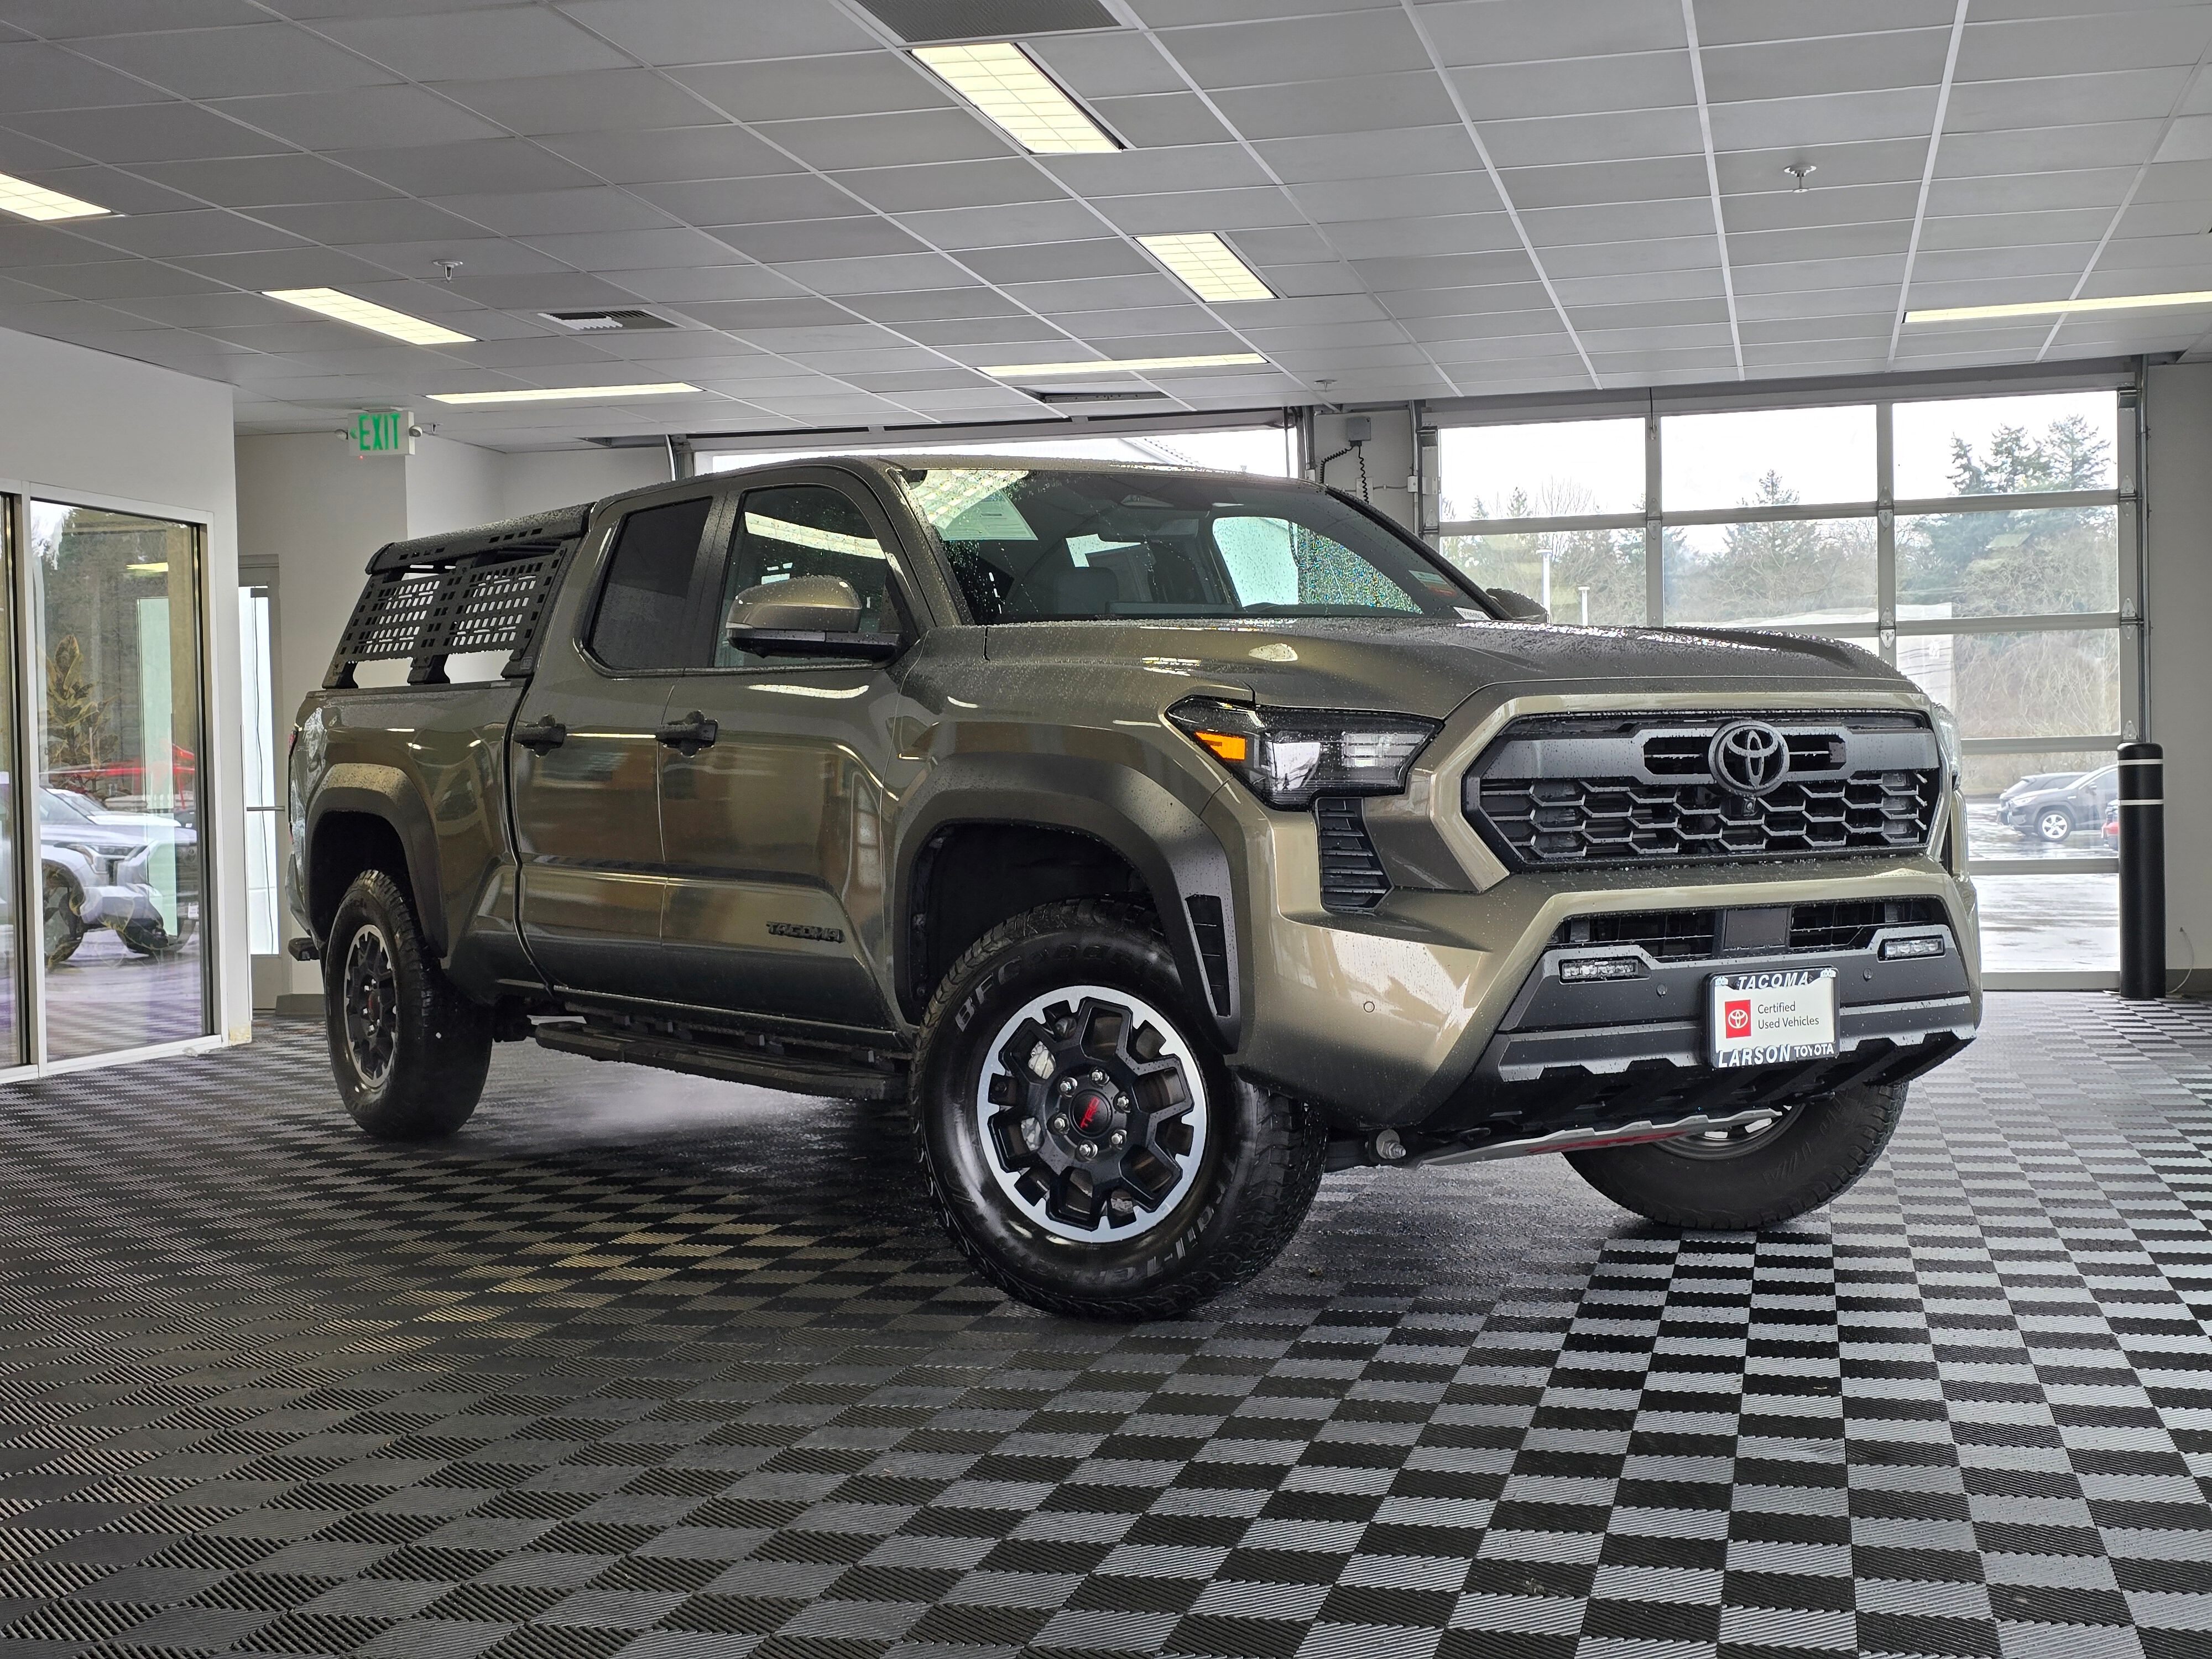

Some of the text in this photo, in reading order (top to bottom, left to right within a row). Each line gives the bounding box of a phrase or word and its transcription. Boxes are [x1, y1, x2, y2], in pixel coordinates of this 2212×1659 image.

[358, 413, 401, 451] EXIT
[1738, 972, 1809, 990] TACOMA
[1757, 1001, 1796, 1015] Certified
[1757, 1015, 1819, 1030] Used Vehicles
[1718, 1043, 1835, 1068] LARSON TOYOTA
